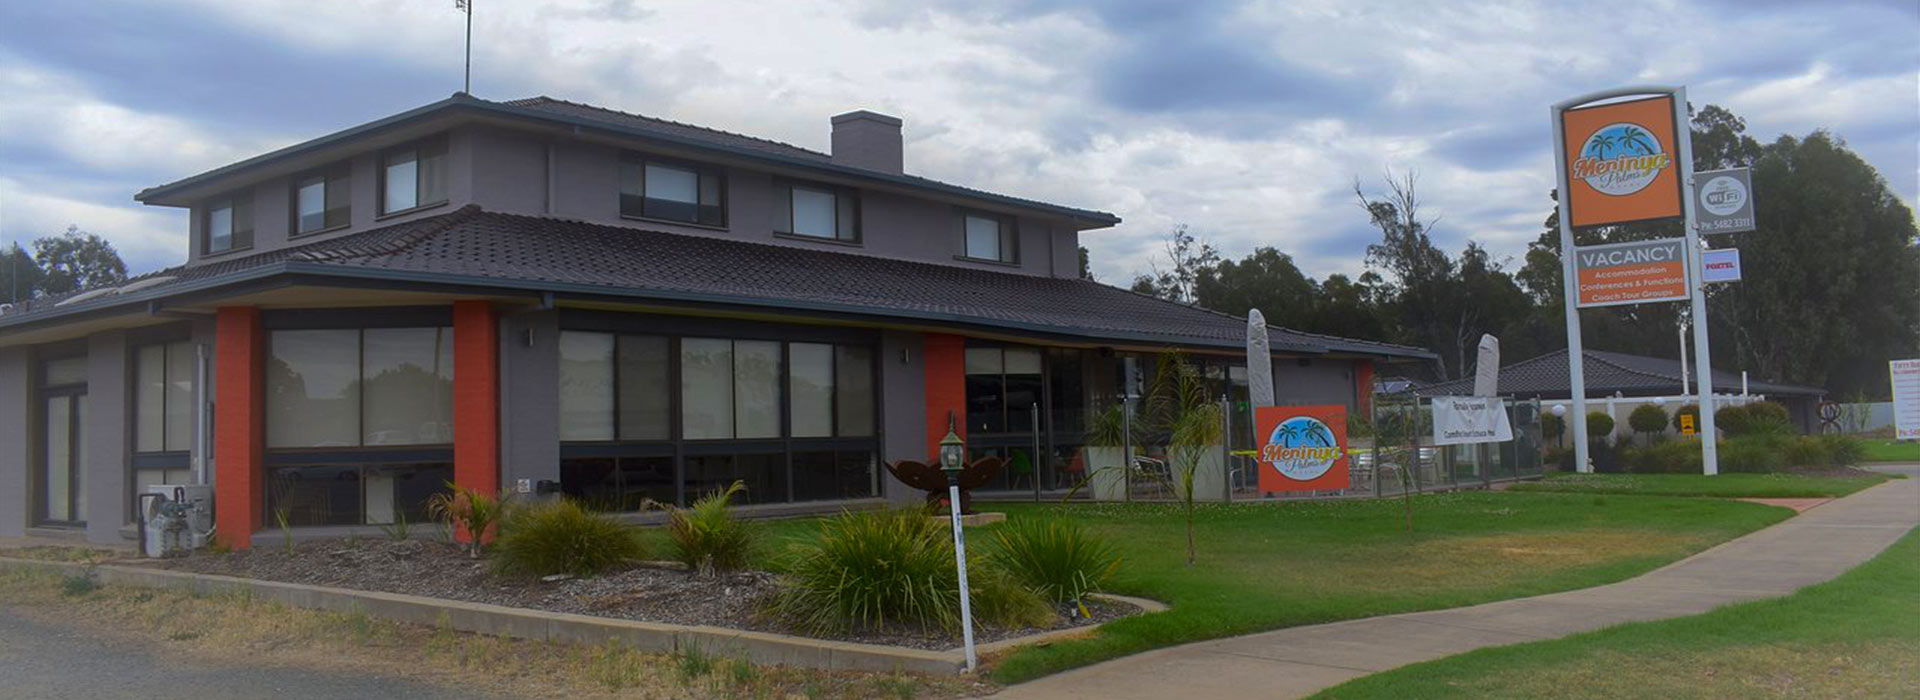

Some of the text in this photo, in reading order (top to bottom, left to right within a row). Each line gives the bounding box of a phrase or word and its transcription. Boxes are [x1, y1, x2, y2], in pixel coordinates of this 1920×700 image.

[1574, 153, 1670, 179] Meninya
[1582, 246, 1675, 267] VACANCY
[1595, 267, 1667, 278] Accommodation
[1580, 281, 1633, 292] Conferences
[1643, 277, 1683, 286] Functions
[1592, 290, 1673, 302] Coach Tour Groups
[1263, 444, 1343, 464] Meninya
